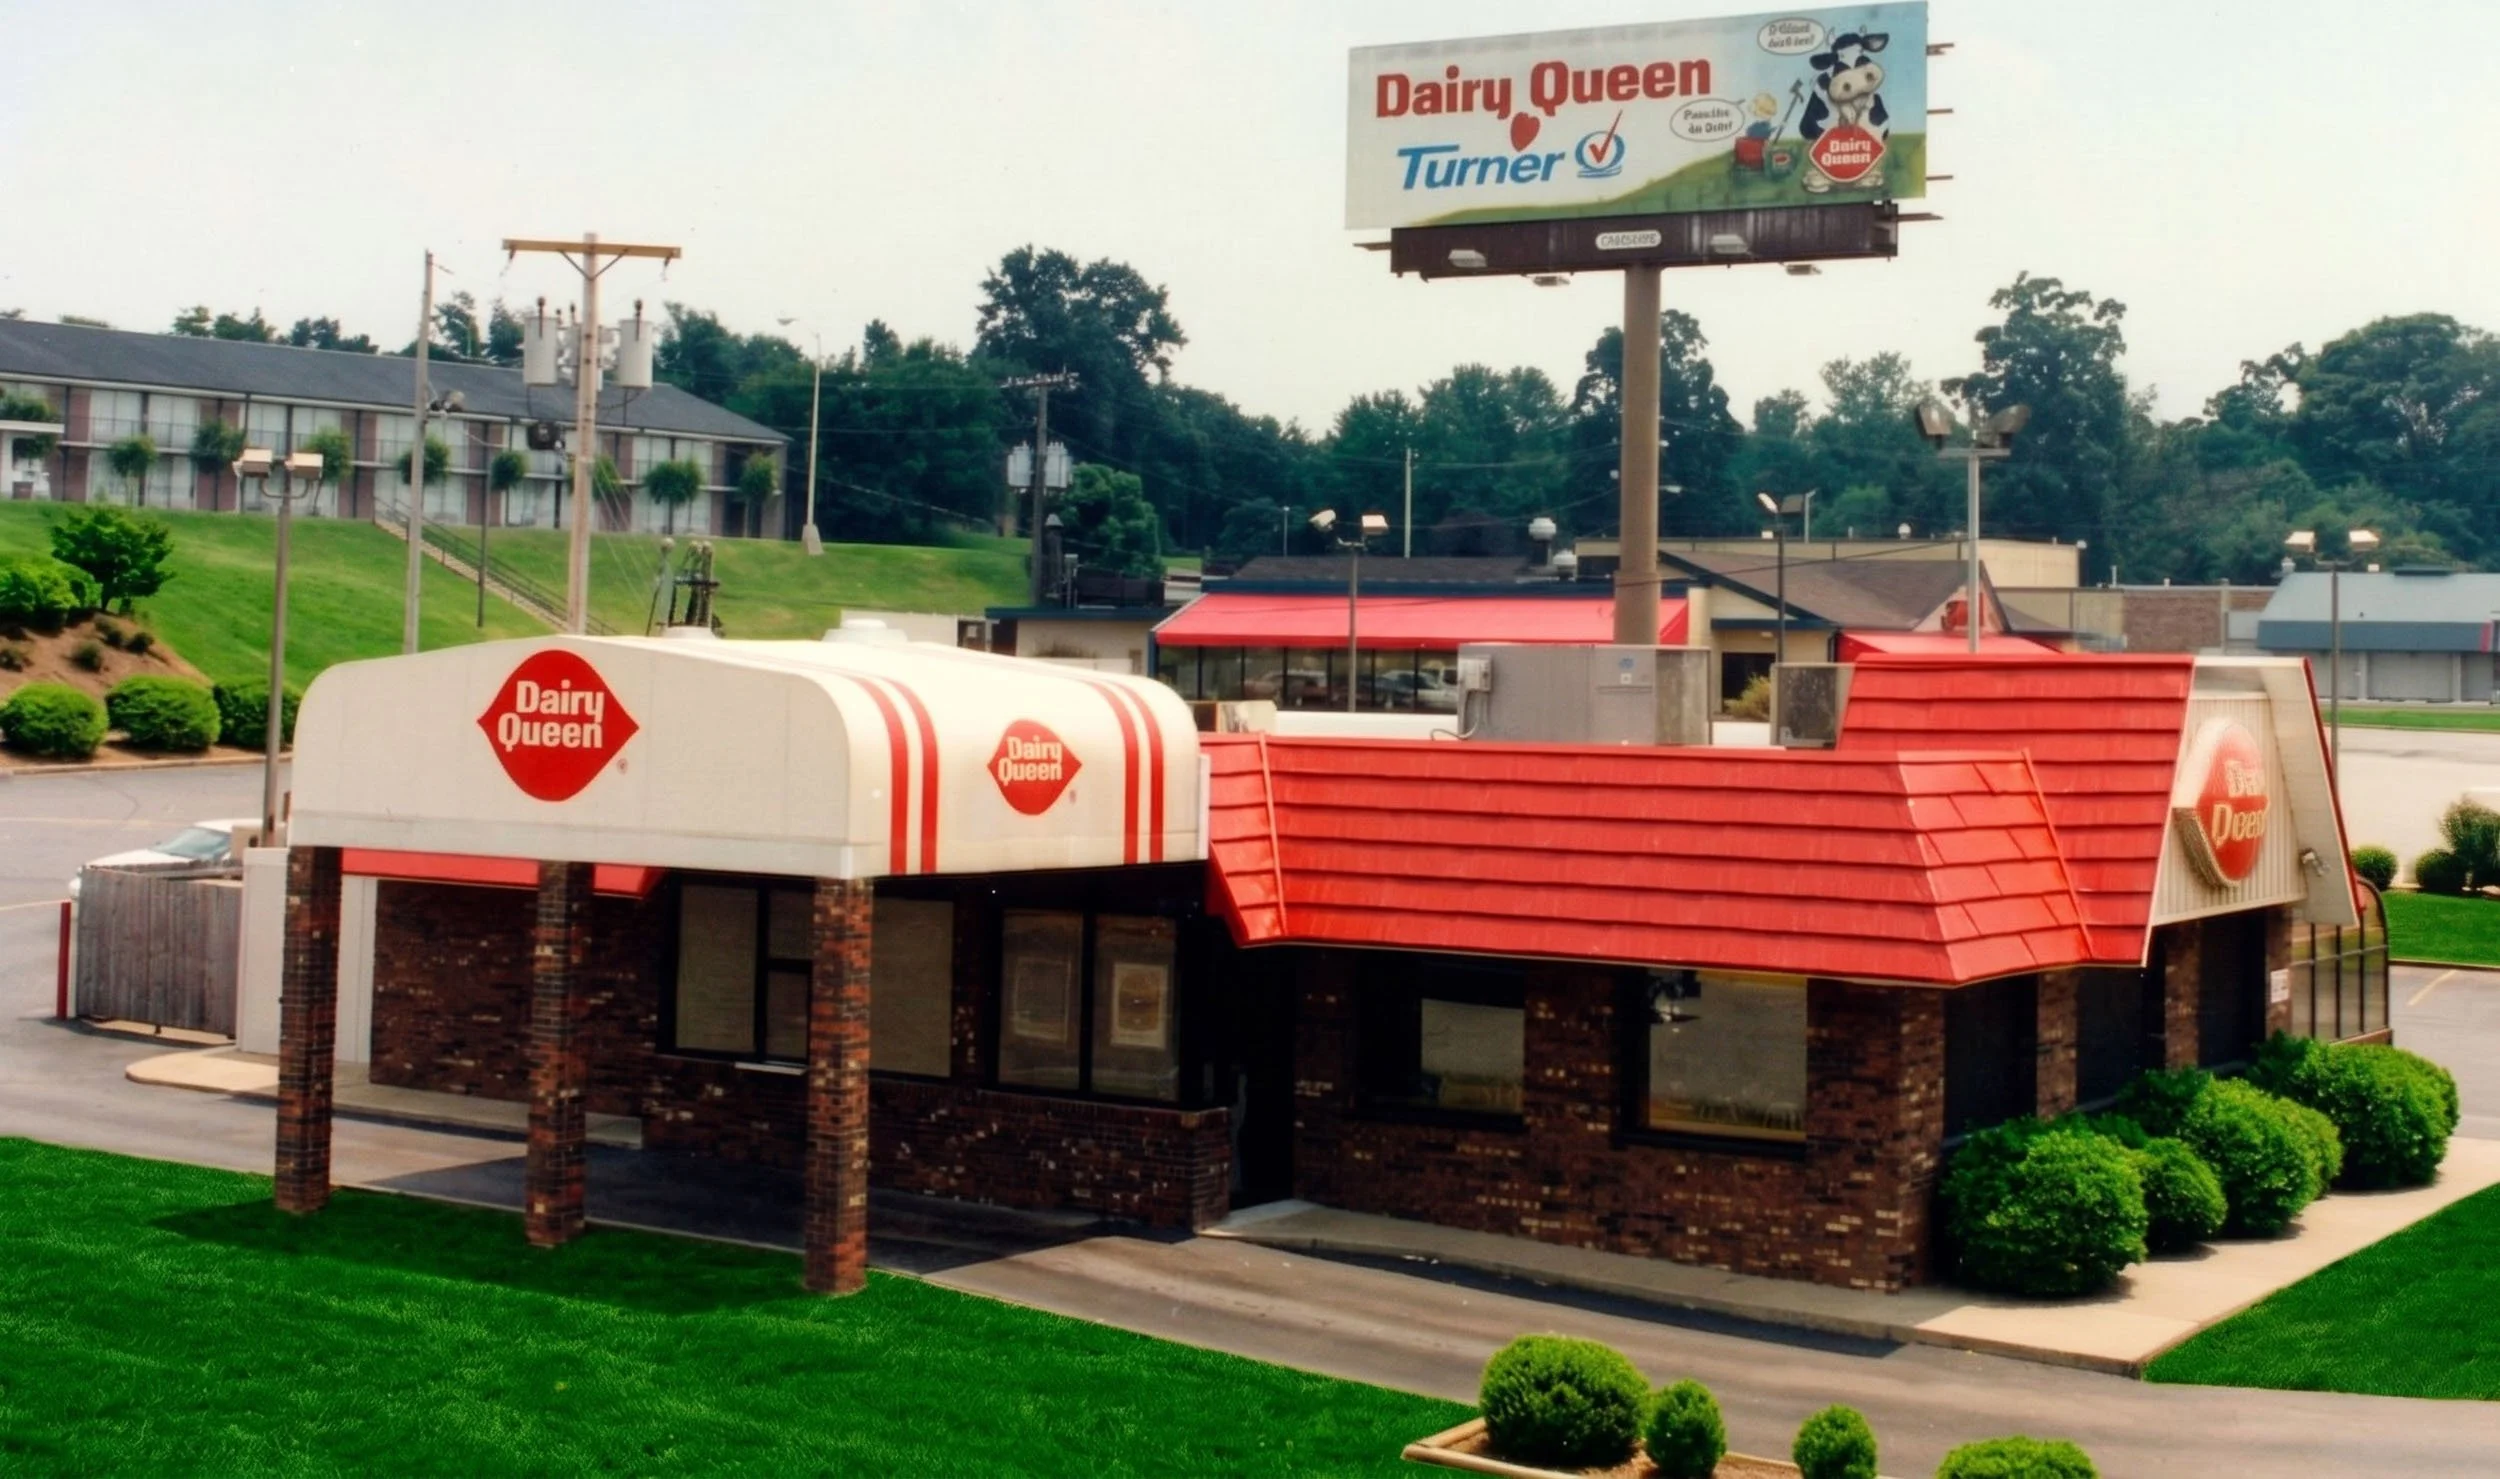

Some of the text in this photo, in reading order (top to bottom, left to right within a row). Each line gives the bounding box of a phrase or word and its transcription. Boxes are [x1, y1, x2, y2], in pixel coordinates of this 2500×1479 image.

[1376, 58, 1711, 118] Dairy Queen
[1397, 144, 1567, 191] Turner
[515, 679, 604, 723] Dairy
[497, 713, 603, 752] Queen
[1006, 735, 1063, 763] Dairy
[998, 757, 1063, 787] Queen
